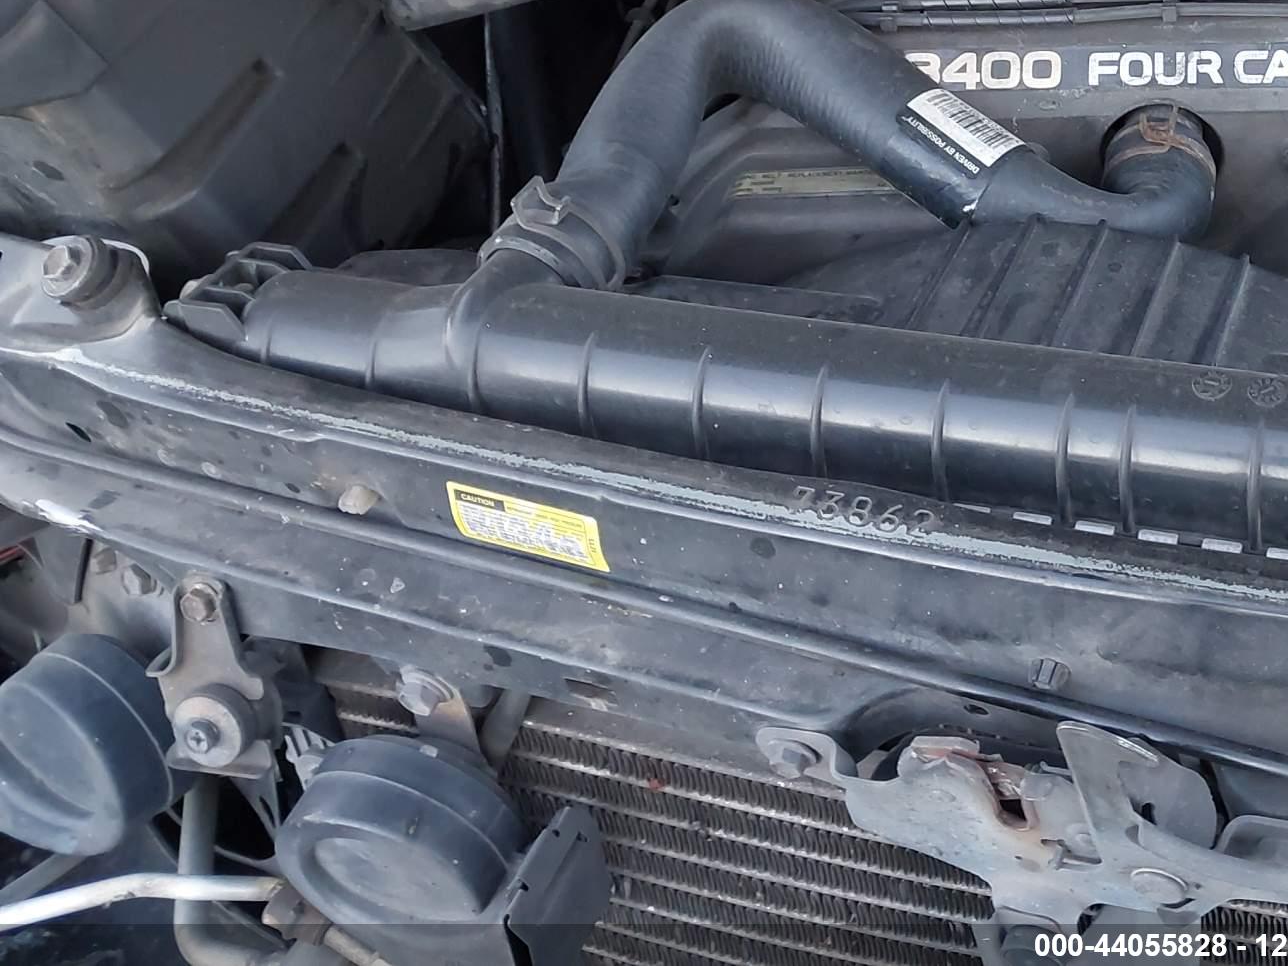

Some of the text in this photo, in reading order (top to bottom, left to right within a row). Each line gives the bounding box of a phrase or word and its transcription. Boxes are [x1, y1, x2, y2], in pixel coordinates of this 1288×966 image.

[1087, 48, 1224, 87] FOUR
[943, 144, 955, 155] BY
[953, 151, 980, 175] DRIVEN
[460, 492, 495, 507] CAUTION
